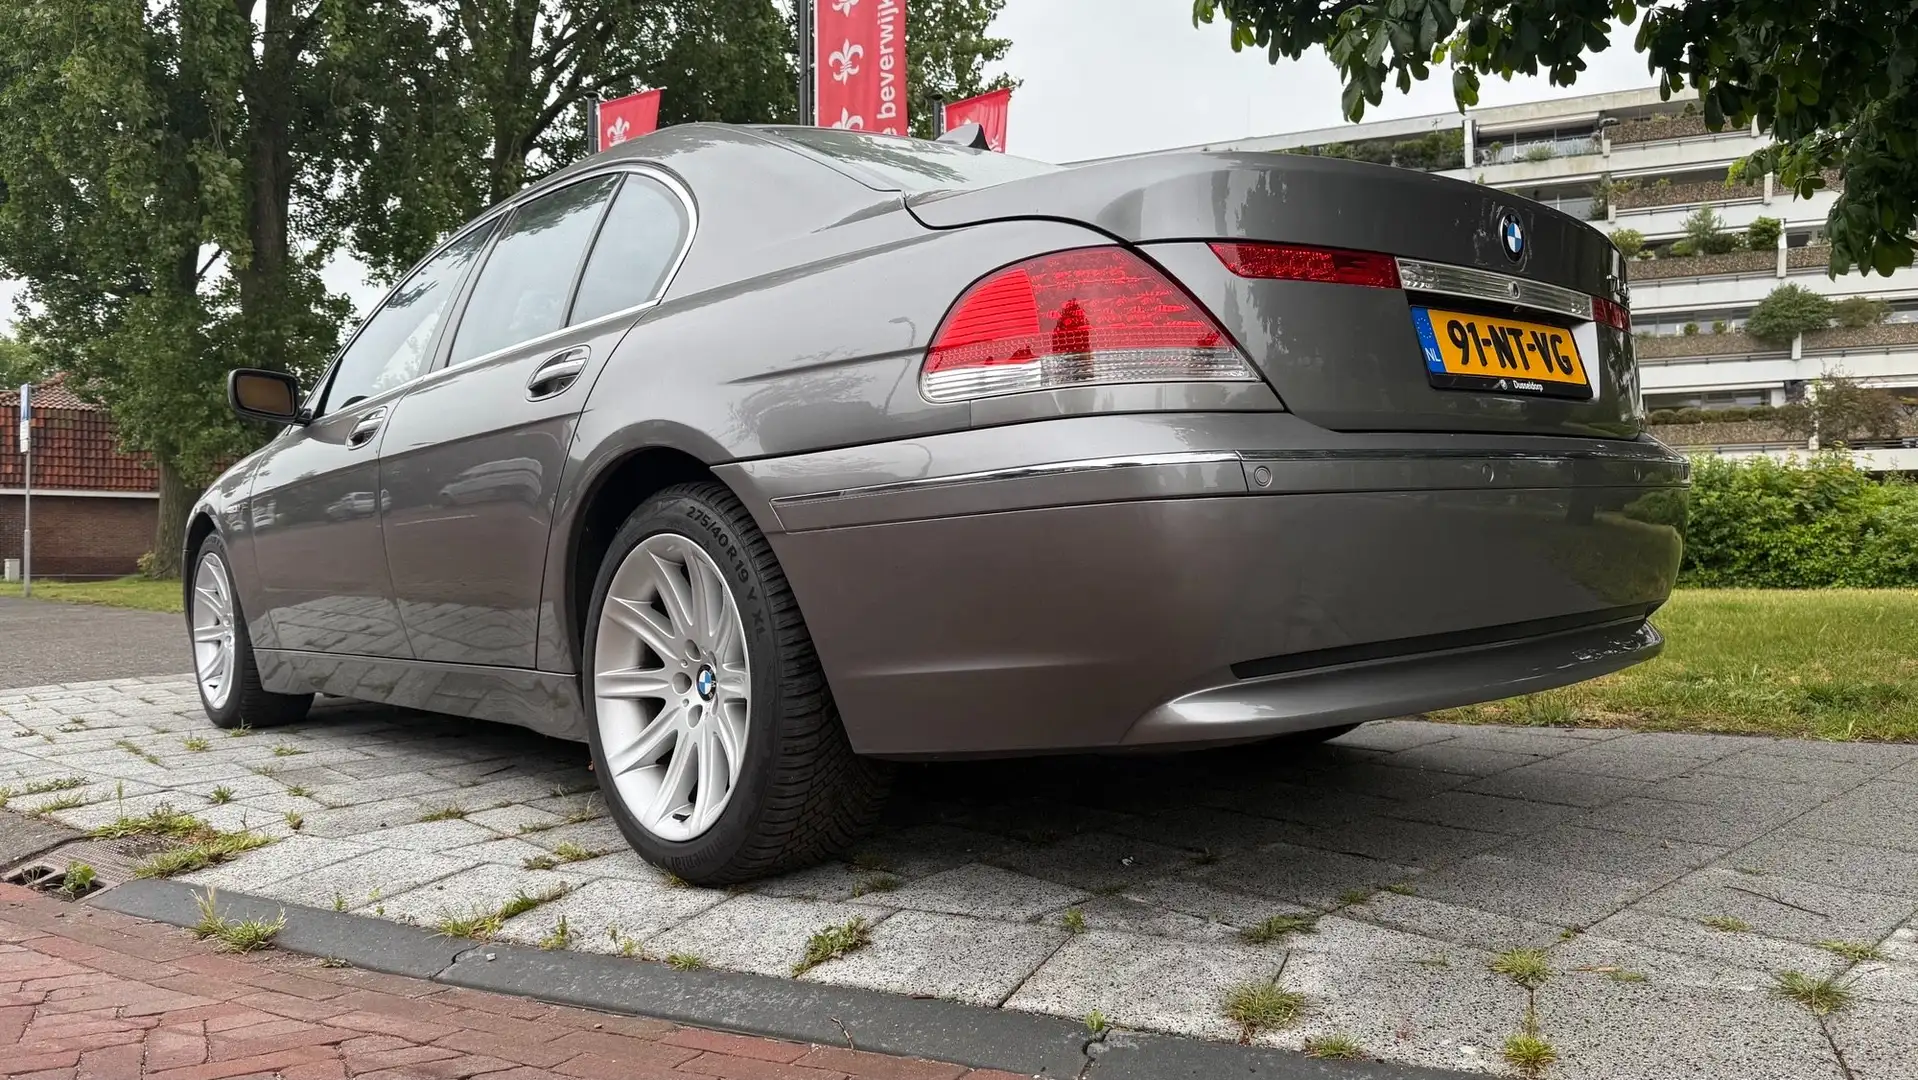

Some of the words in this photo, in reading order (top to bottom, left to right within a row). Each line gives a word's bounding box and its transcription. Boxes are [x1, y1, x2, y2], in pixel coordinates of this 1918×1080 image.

[877, 0, 899, 119] beverwijk
[1424, 347, 1441, 362] NL
[1446, 319, 1574, 375] 91-NT-VG
[1513, 379, 1543, 392] Dusseldorp
